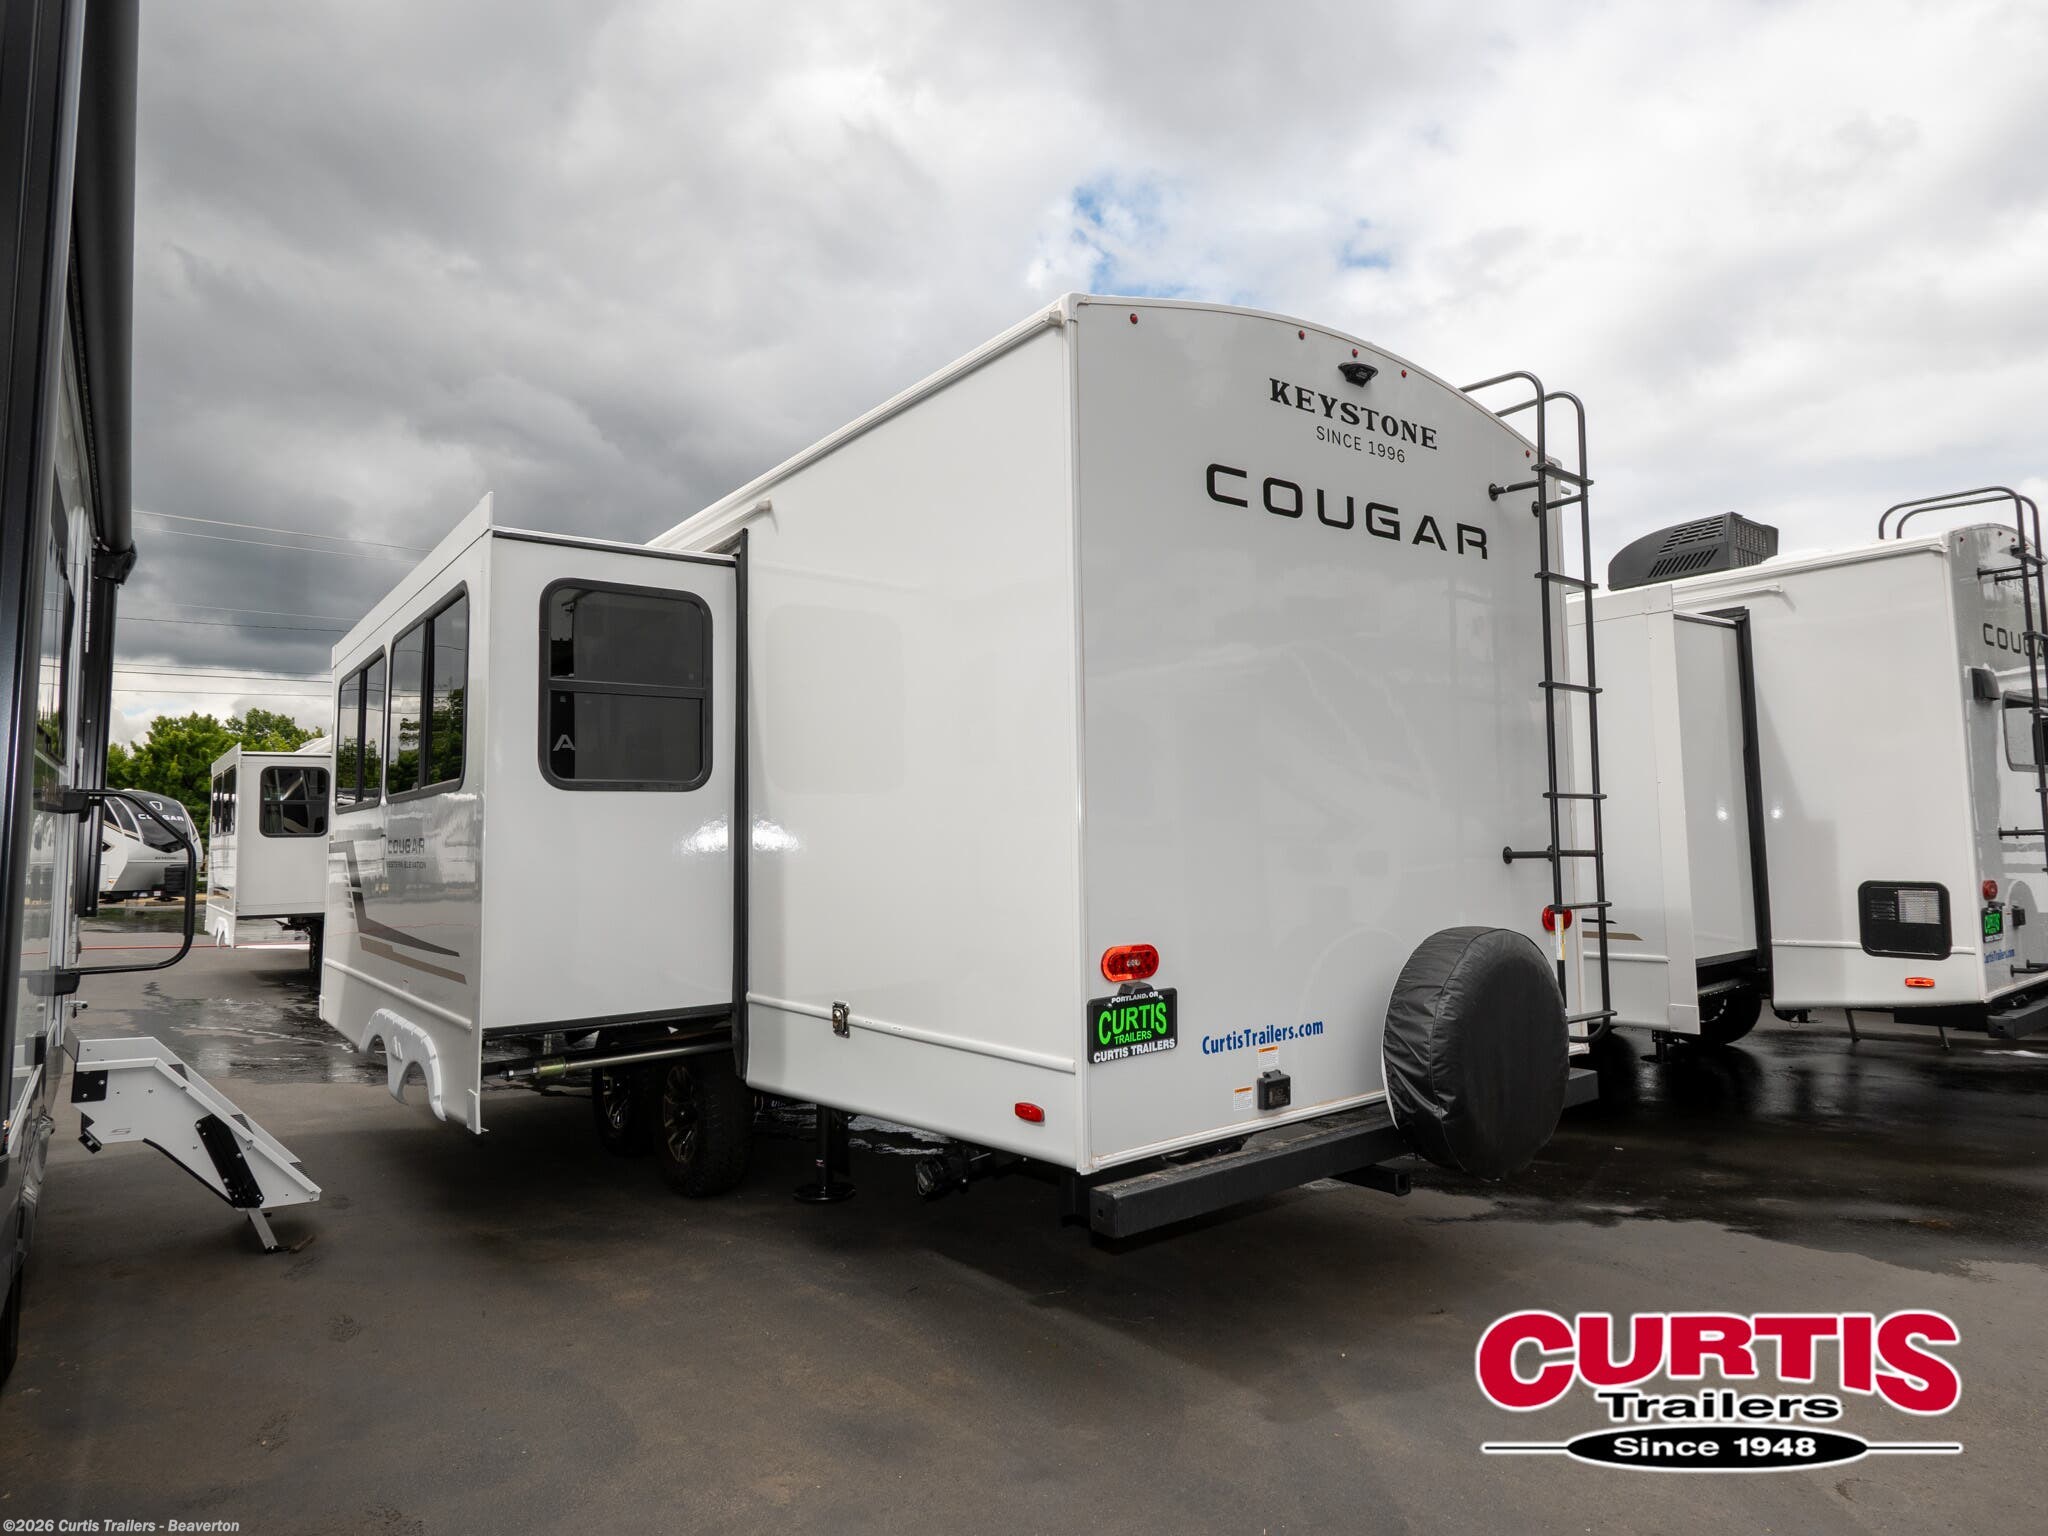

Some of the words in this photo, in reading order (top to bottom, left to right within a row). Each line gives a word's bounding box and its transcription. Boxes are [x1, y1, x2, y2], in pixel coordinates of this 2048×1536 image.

[1269, 377, 1438, 451] KEYSTONE
[1315, 425, 1362, 452] SINCE
[1367, 440, 1406, 464] 1996
[1205, 462, 1489, 561] COUGAR
[387, 837, 425, 854] COUGAR
[1149, 990, 1159, 998] OR
[1098, 1002, 1167, 1045] CURTIS
[1114, 1030, 1152, 1045] TRAILERS
[1202, 1020, 1324, 1055] CurtisTrailers.com
[1093, 1047, 1129, 1063] CURTIS
[1131, 1038, 1175, 1056] TRAILERS
